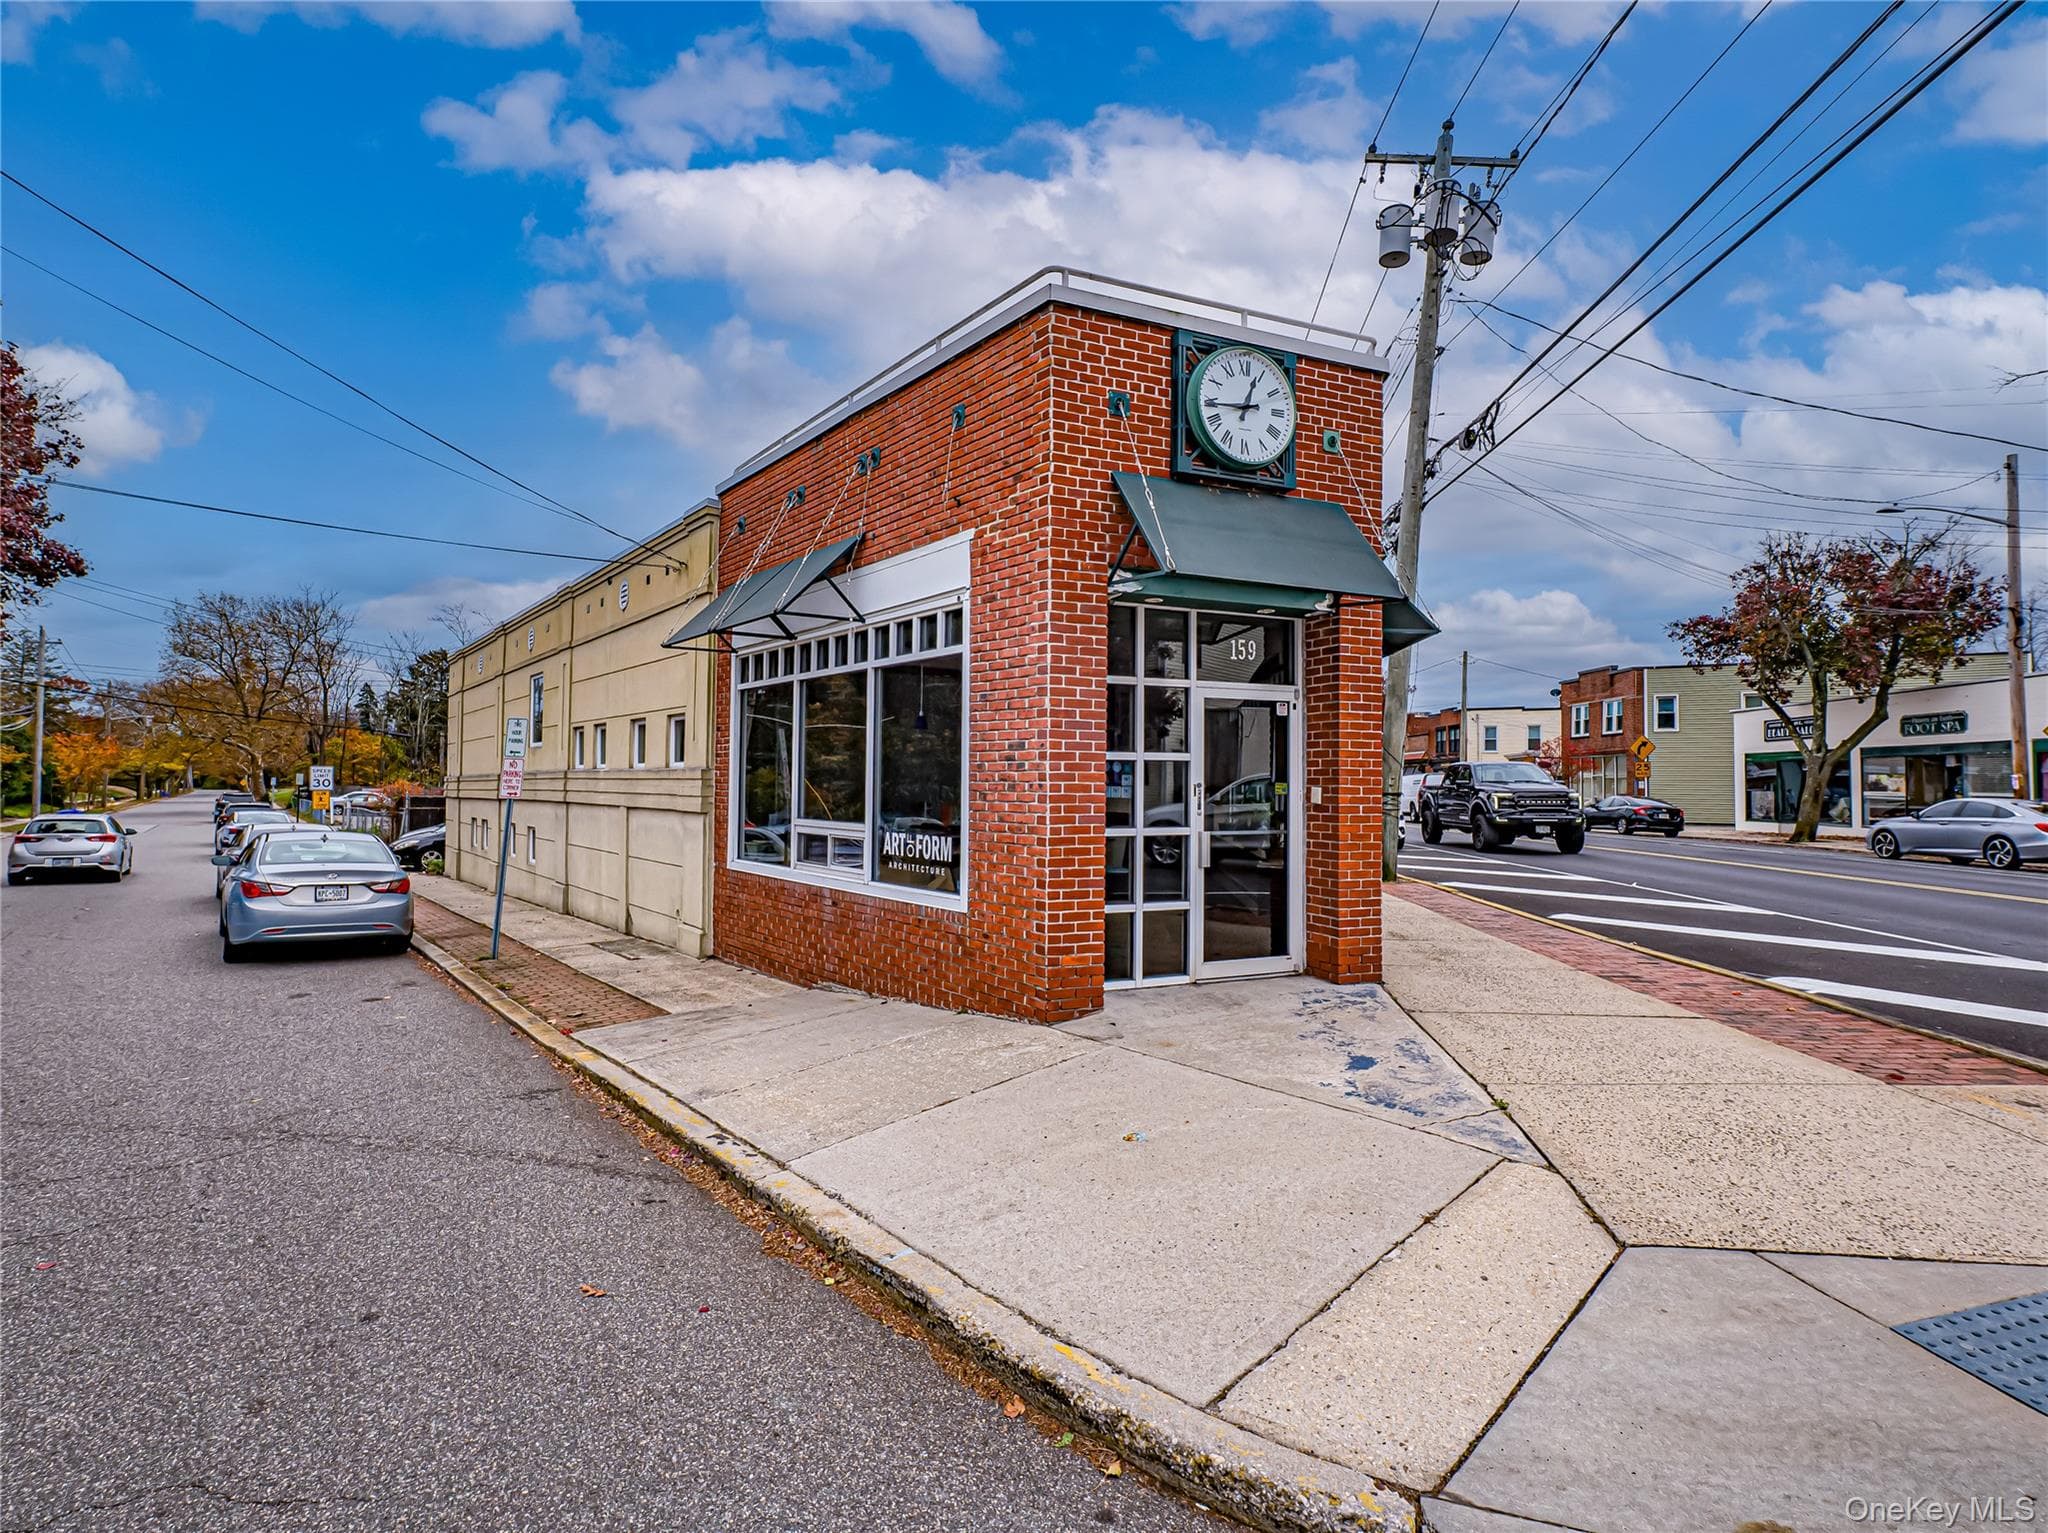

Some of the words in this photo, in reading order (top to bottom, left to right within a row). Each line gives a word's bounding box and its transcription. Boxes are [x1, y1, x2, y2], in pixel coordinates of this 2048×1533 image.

[1221, 360, 1235, 379] XI
[1239, 360, 1251, 377] XII
[1208, 377, 1223, 391] X
[1267, 387, 1281, 398] II
[1270, 408, 1285, 419] III
[1240, 438, 1250, 456] VI
[1230, 639, 1256, 660] 159
[1904, 722, 1937, 736] FOOT
[1940, 720, 1961, 733] SPA
[509, 761, 518, 769] NO
[1636, 763, 1650, 771] 25
[503, 770, 522, 778] PARKING
[312, 778, 331, 788] 30
[883, 831, 906, 857] ART
[915, 834, 953, 862] FORM
[888, 861, 946, 876] ARCHITECTURE
